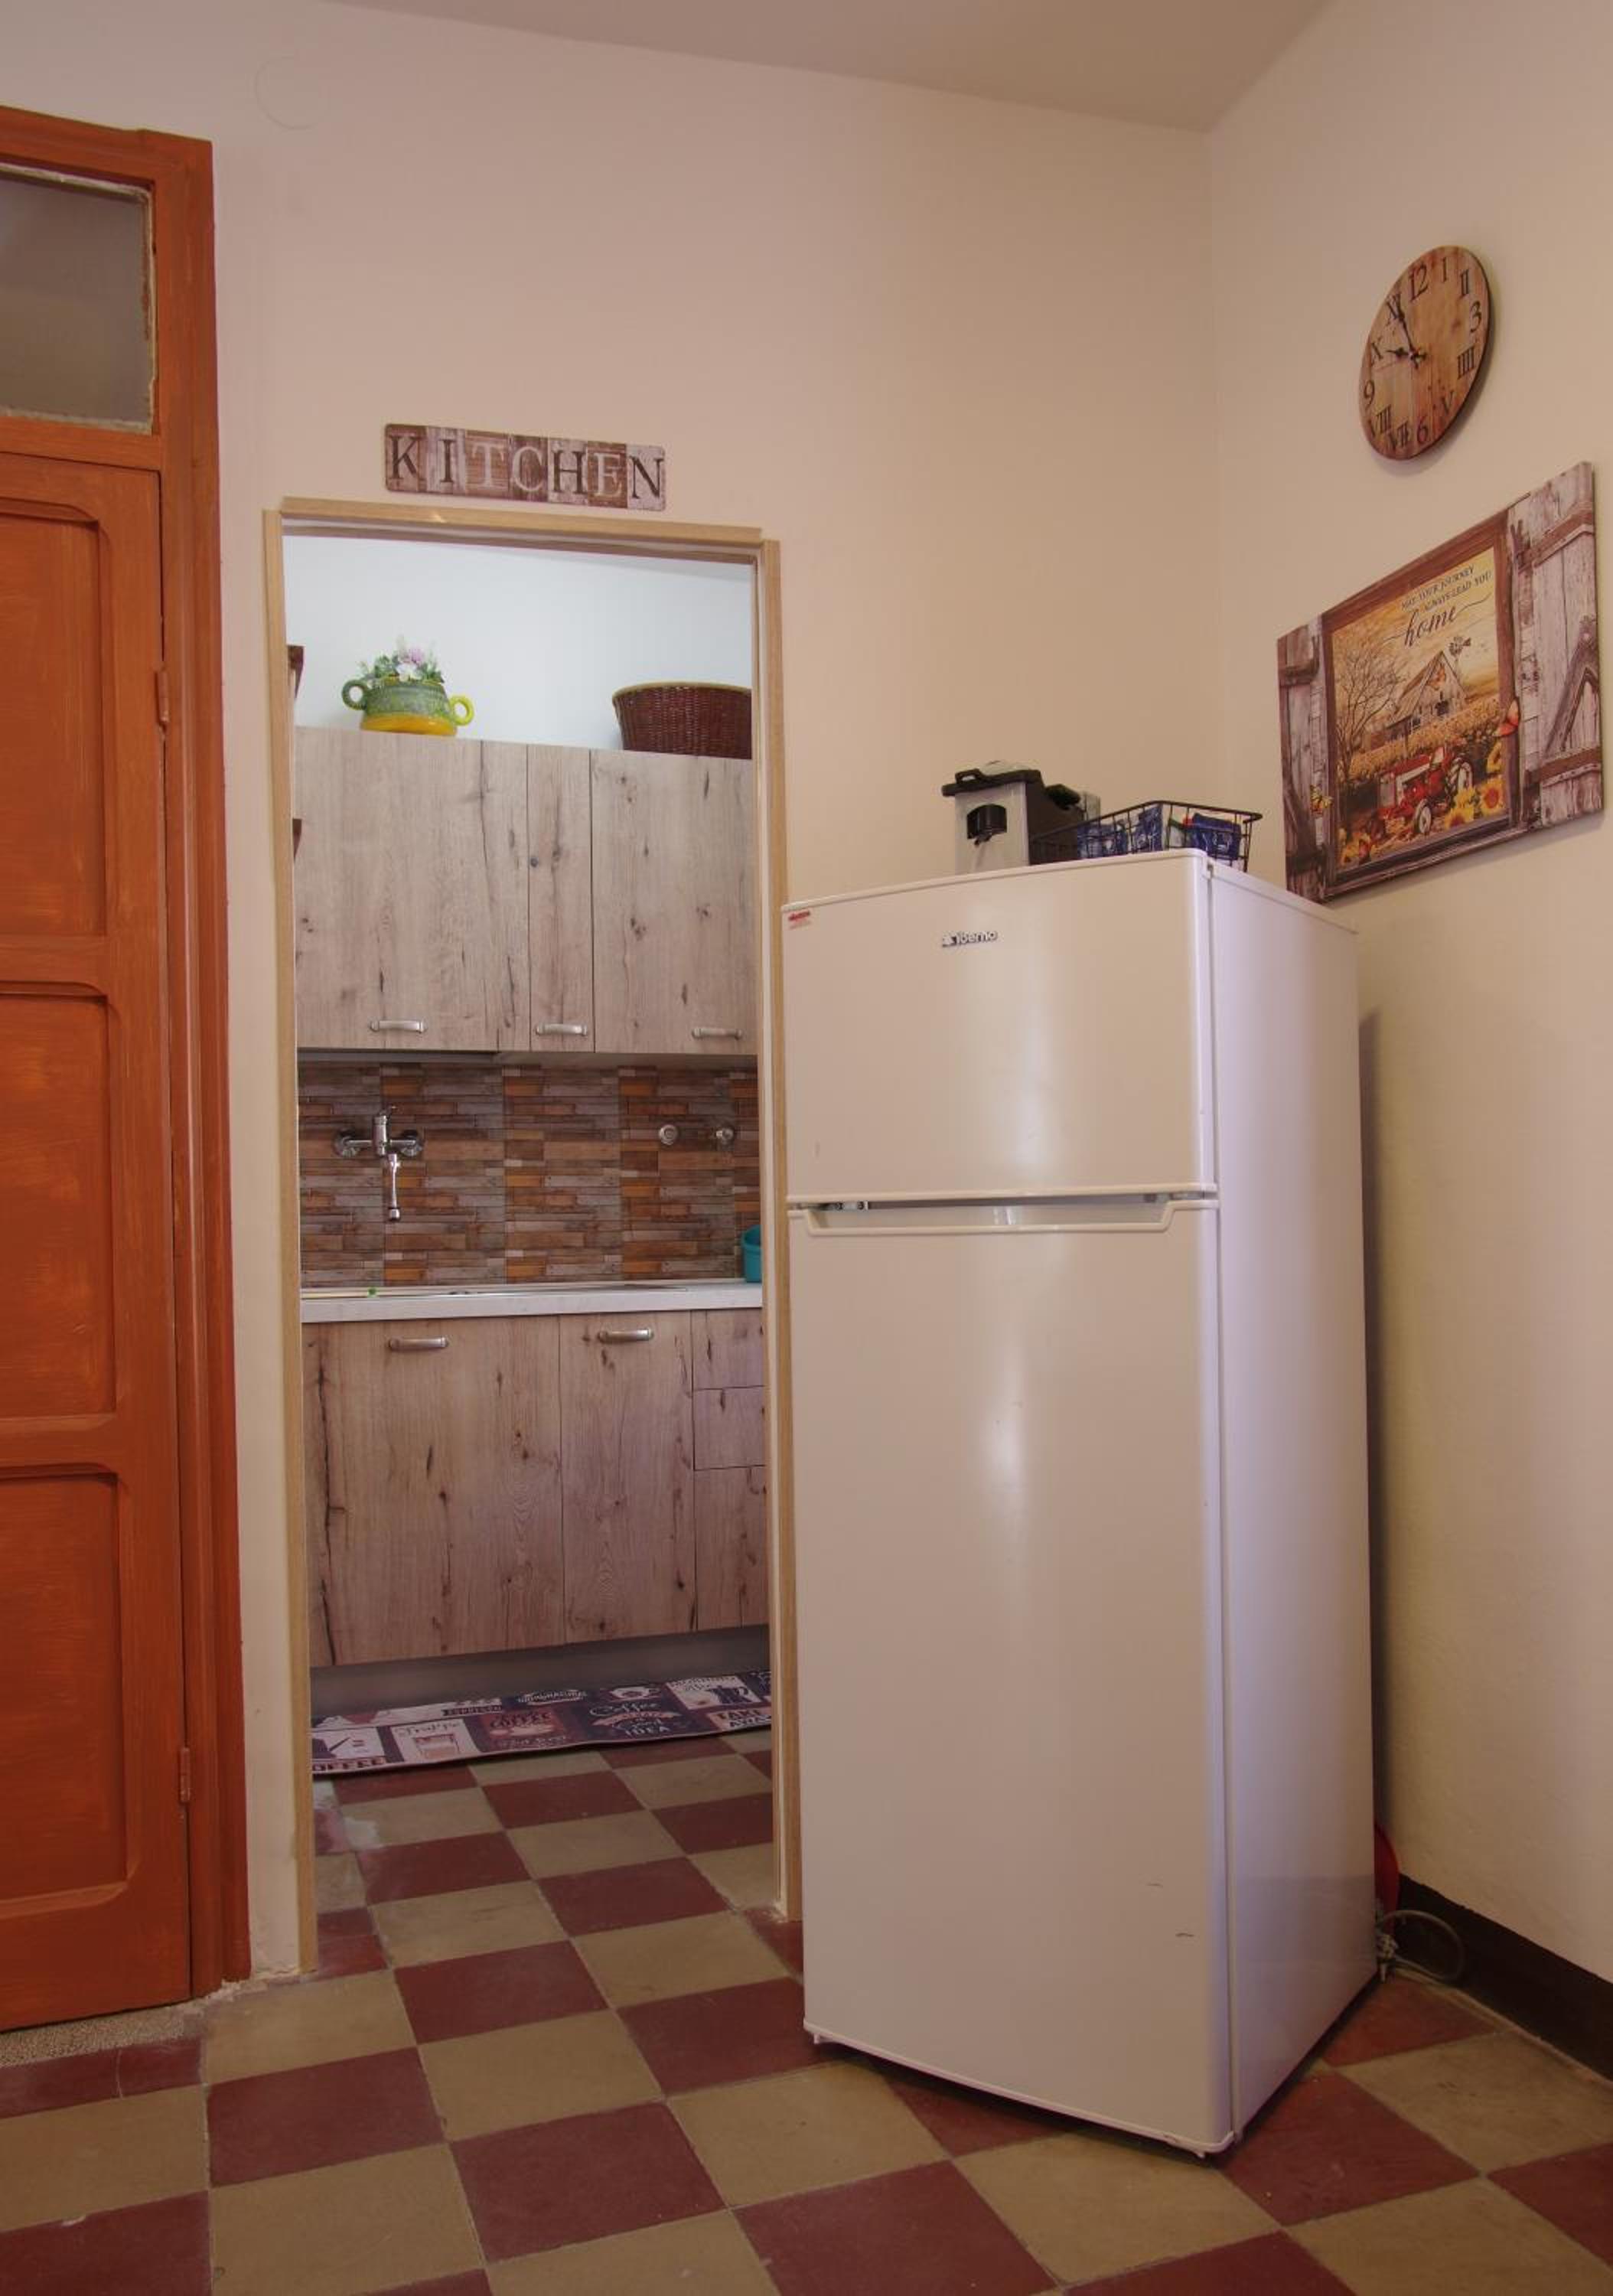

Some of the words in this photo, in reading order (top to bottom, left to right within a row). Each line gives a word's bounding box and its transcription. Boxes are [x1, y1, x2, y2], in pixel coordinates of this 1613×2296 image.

[1409, 264, 1429, 302] 12
[1460, 269, 1470, 298] II
[1470, 301, 1482, 333] 3
[1363, 379, 1375, 411] 9
[1416, 417, 1429, 445] 6
[388, 434, 665, 500] KITCHEN
[1404, 606, 1456, 648] home
